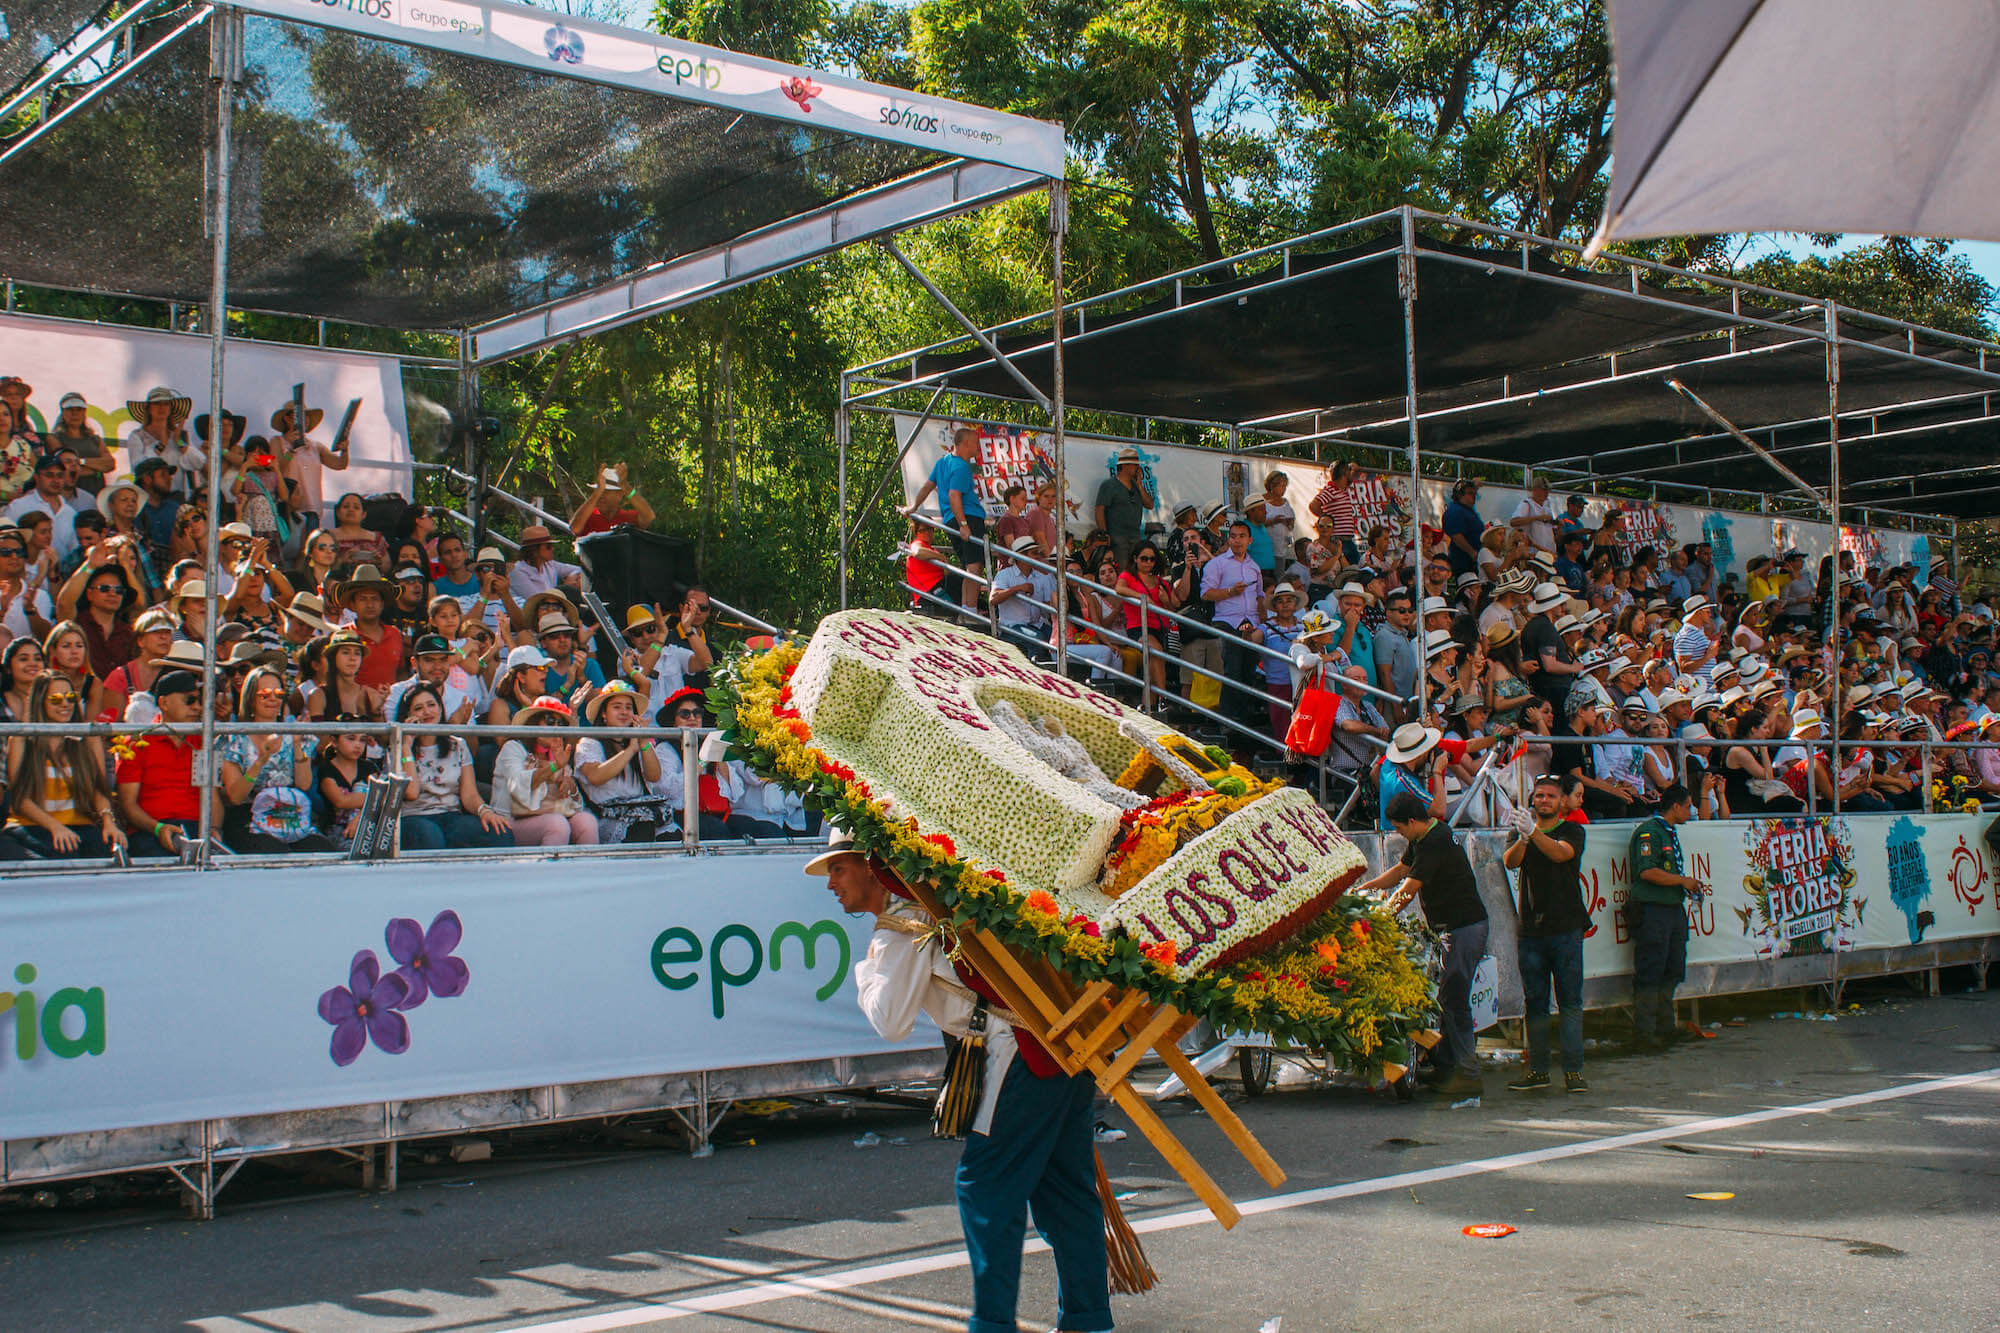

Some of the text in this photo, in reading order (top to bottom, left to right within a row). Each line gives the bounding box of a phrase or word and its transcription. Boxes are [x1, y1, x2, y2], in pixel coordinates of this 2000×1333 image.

[410, 8, 447, 27] Grupo
[450, 18, 482, 35] epm
[657, 54, 721, 90] epm
[880, 105, 938, 133] somos
[950, 124, 979, 139] Grupo
[979, 435, 1035, 464] ERIA
[982, 461, 1028, 478] DE LAS
[1348, 480, 1387, 504] ERIA
[1624, 509, 1657, 531] ERIA
[1767, 825, 1829, 871] FERIA
[1888, 841, 1920, 866] 60 AÑOS
[1783, 860, 1823, 886] DE LAS
[1136, 870, 1238, 967] LOS
[1218, 822, 1309, 901] QUE
[1768, 874, 1842, 925] FLORES
[650, 919, 851, 1020] epm
[1471, 987, 1493, 1005] epm
[0, 962, 106, 1060] ia
